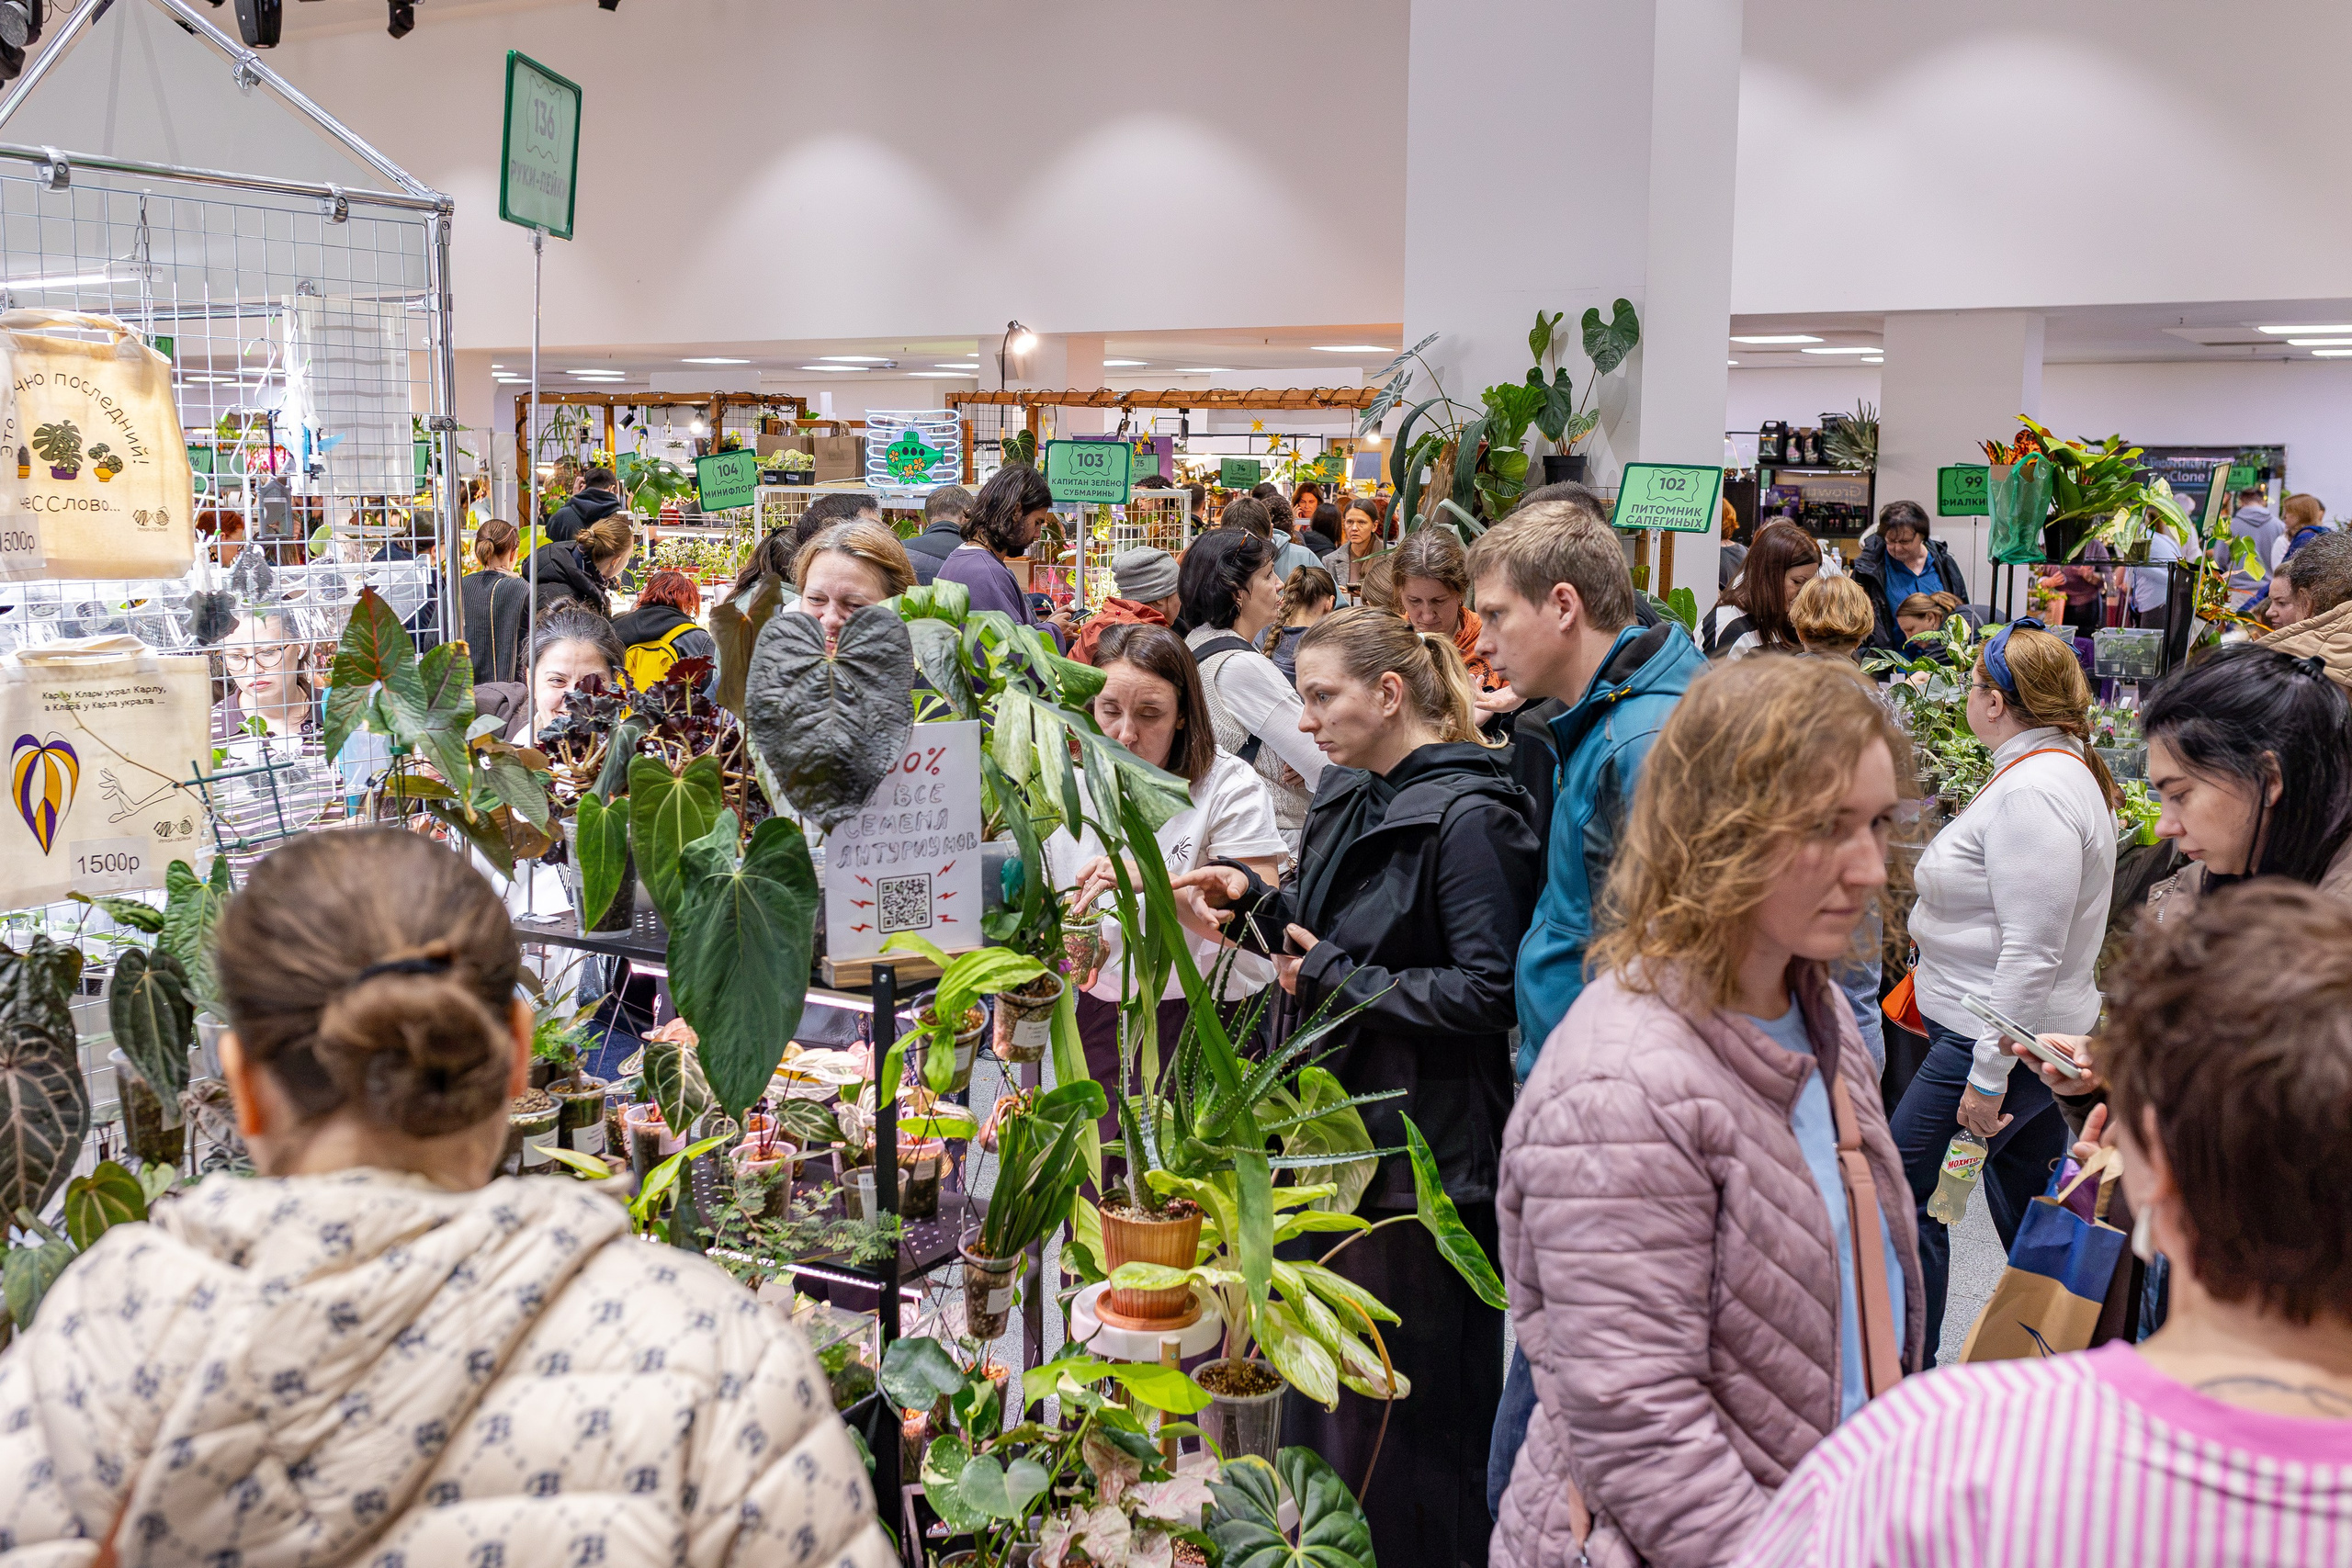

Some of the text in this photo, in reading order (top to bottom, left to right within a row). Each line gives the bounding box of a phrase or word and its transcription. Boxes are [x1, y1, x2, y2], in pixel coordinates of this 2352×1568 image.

[534, 97, 555, 141] 136
[1077, 452, 1104, 468] 103
[1135, 459, 1145, 468] 75
[717, 462, 739, 479] 104
[1237, 464, 1246, 472] 74
[1051, 478, 1090, 487] КАПИТАН
[1659, 477, 1687, 491] 102
[1965, 476, 1984, 488] 99
[1063, 488, 1115, 498] СУБМАРИНЫ
[1631, 503, 1702, 517] ПИТОМНИК
[1625, 514, 1703, 528] САПЕГИНЫХ
[74, 689, 102, 700] Клары
[105, 686, 130, 698] украл
[84, 703, 90, 712] у
[92, 700, 118, 711] Карла
[120, 697, 154, 709] украла
[893, 783, 945, 807] ВСЕ
[77, 852, 140, 874] 1500р
[1947, 1157, 1979, 1169] МОХИТО
